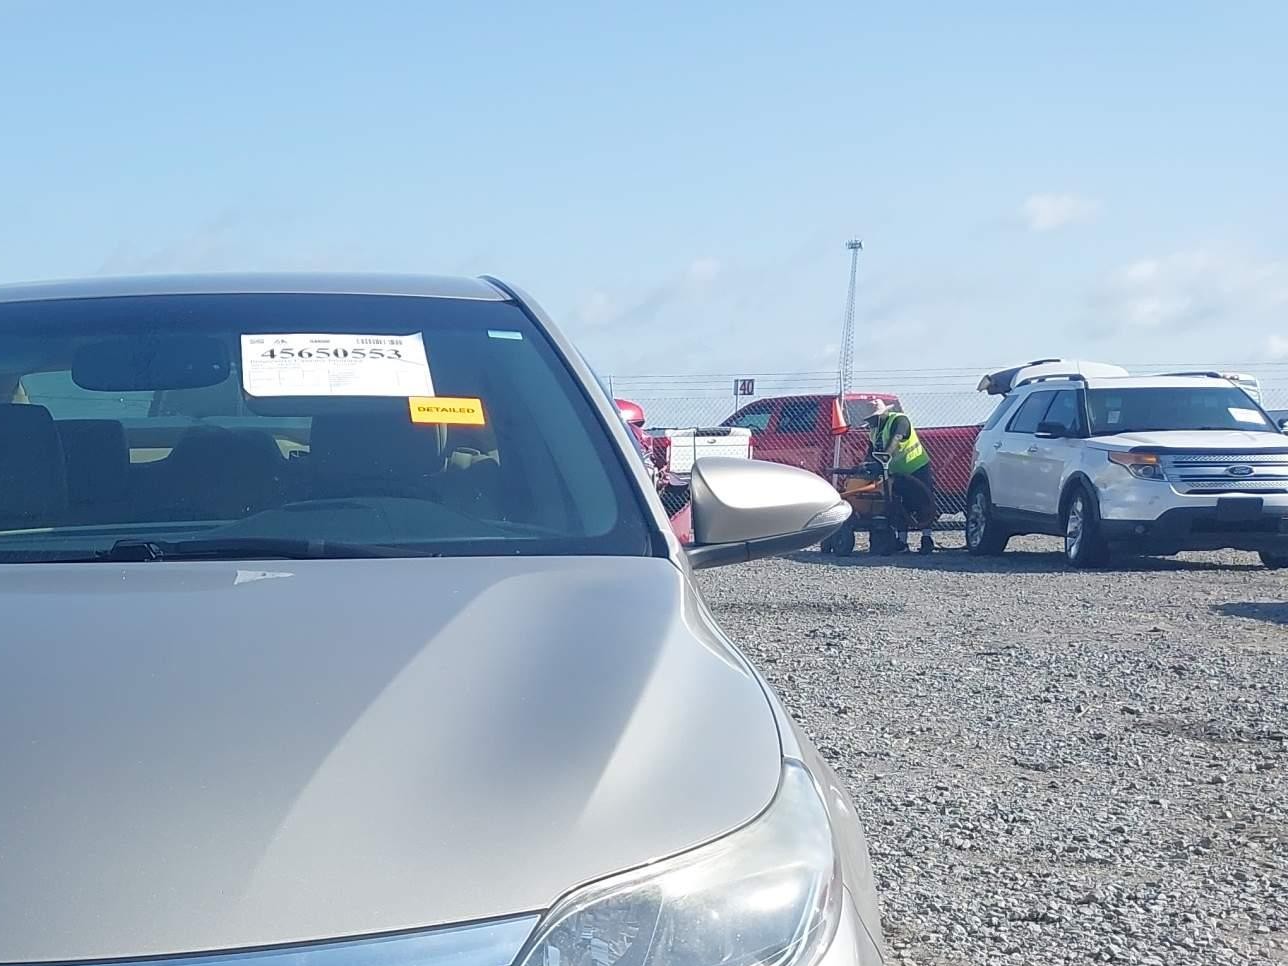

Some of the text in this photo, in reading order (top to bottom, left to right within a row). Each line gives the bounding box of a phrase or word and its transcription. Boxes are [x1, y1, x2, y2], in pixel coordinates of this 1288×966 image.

[260, 347, 403, 360] 45650553
[739, 379, 754, 395] 40
[417, 406, 476, 414] DETAILED
